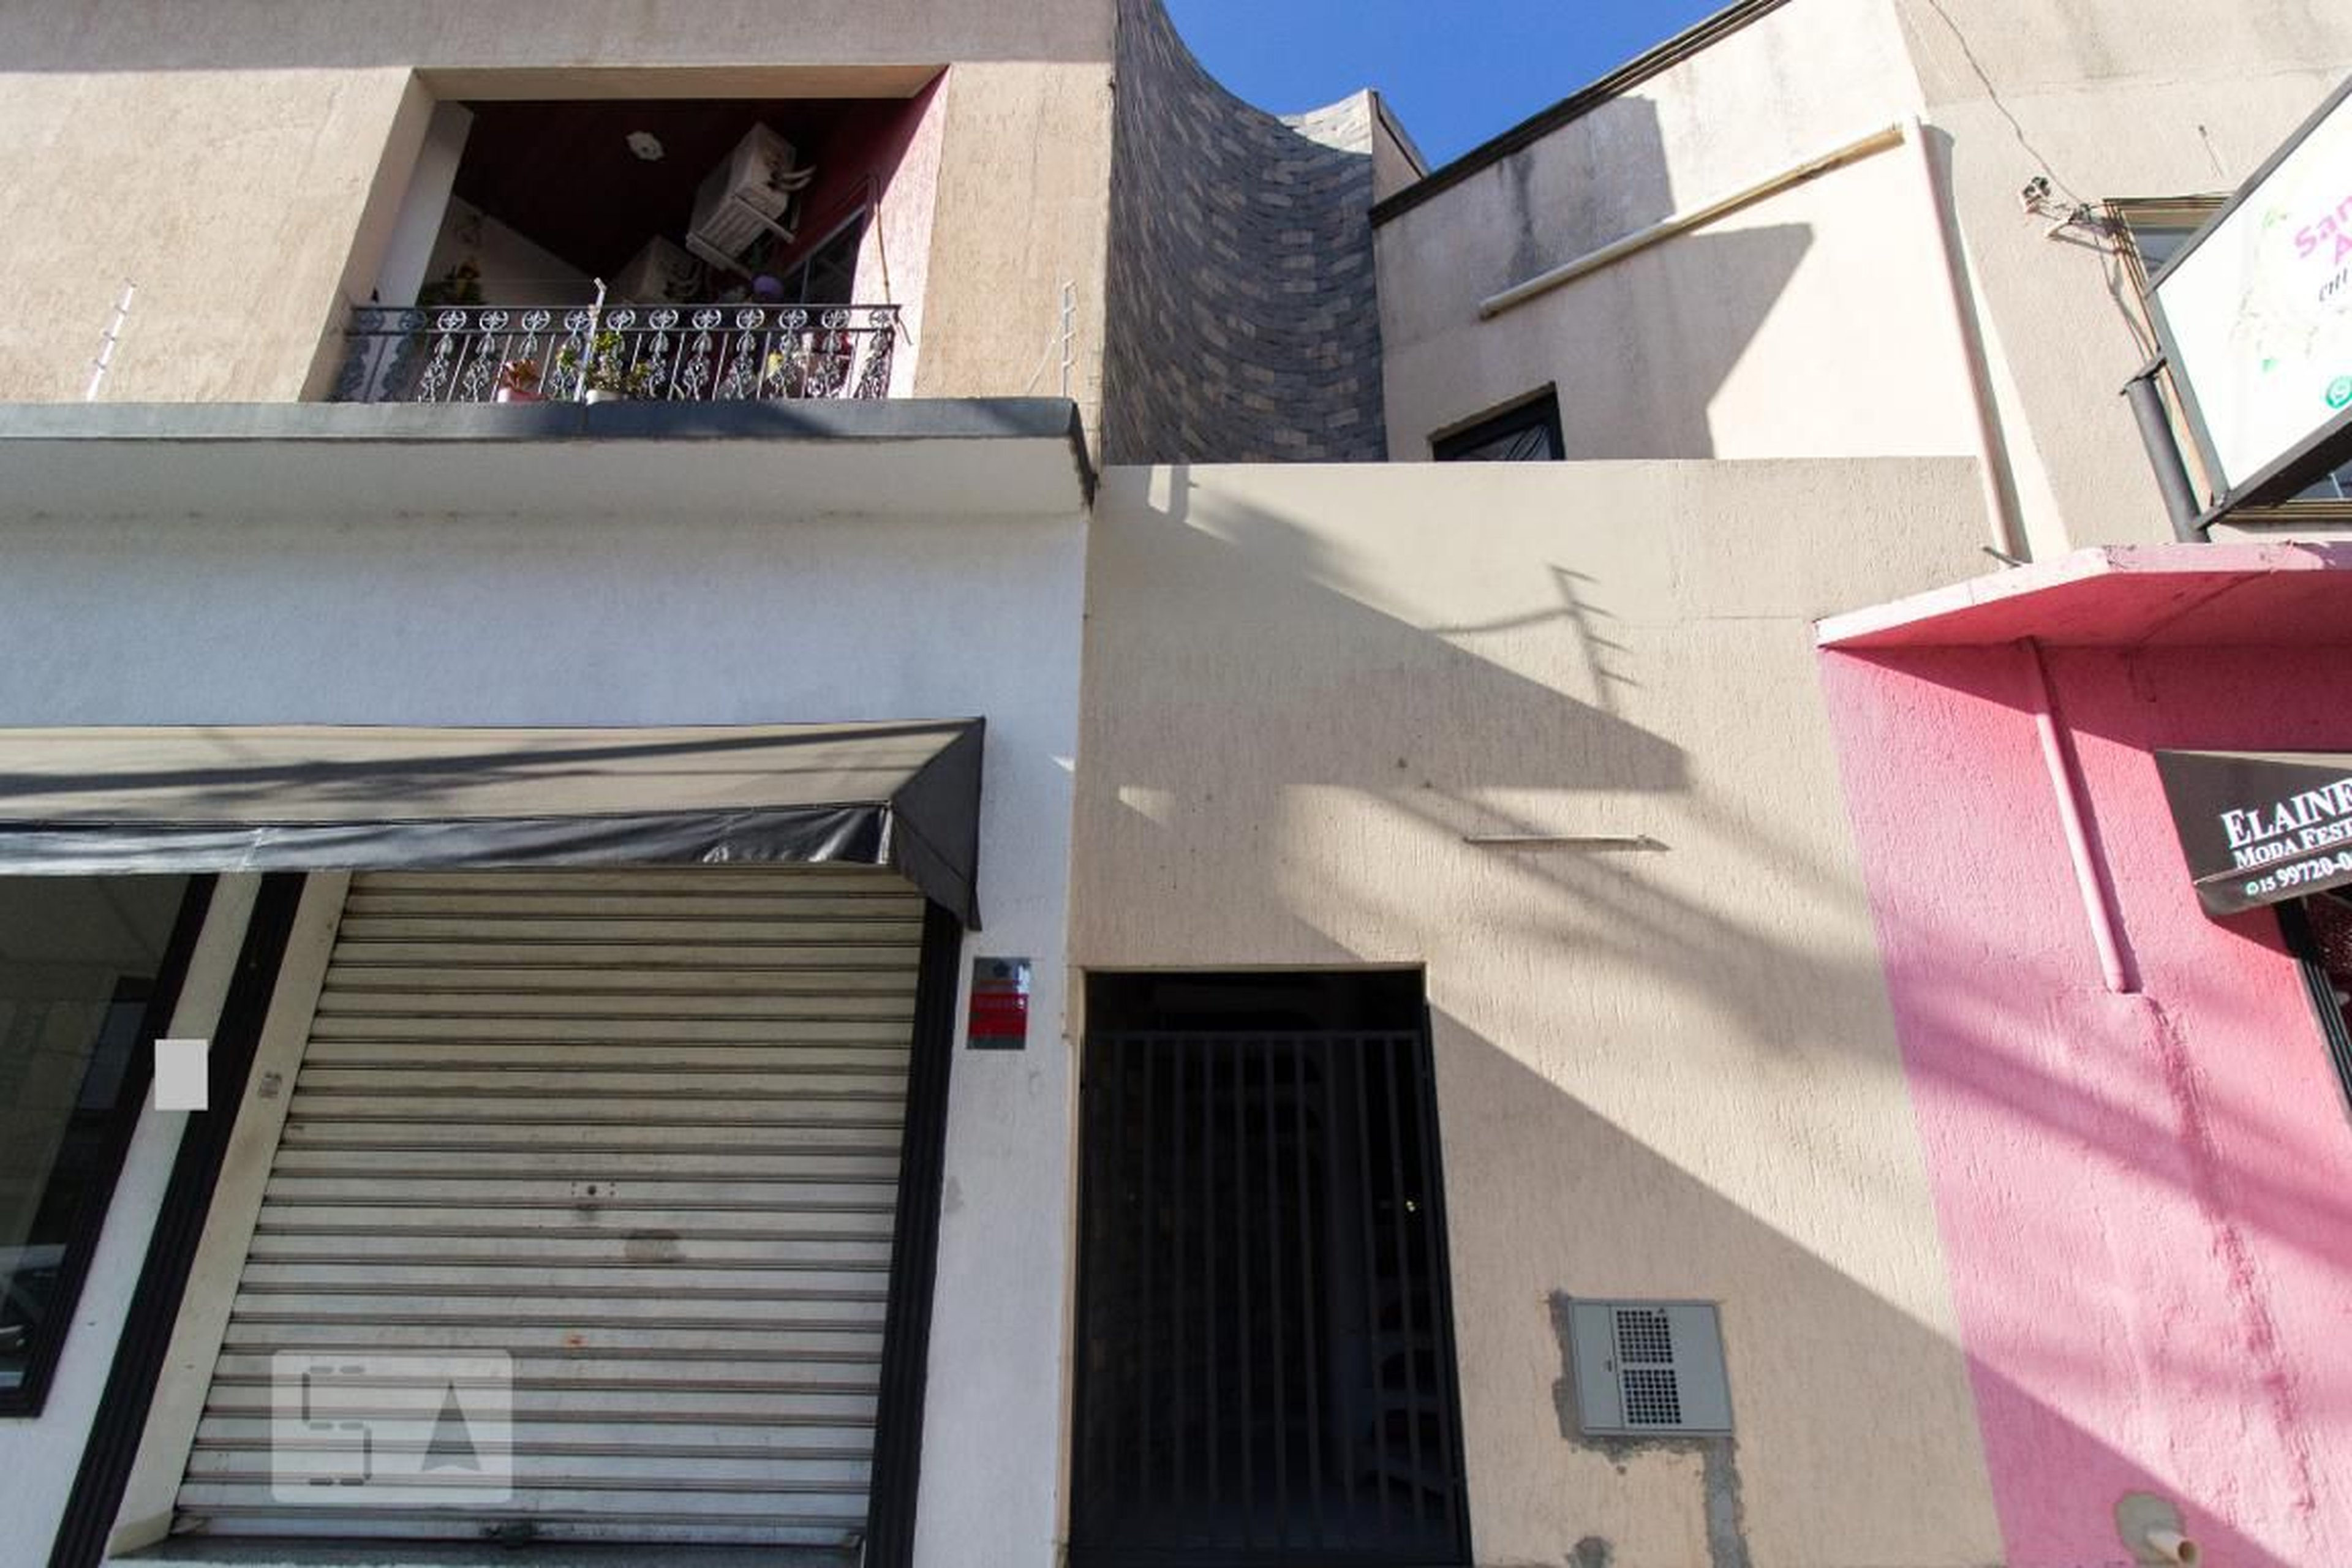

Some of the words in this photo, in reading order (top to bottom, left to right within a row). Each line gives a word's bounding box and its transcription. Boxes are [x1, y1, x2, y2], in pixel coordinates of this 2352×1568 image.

[2221, 777, 2352, 850] ELAINE
[2232, 839, 2298, 870] MODA
[2259, 876, 2276, 892] 15
